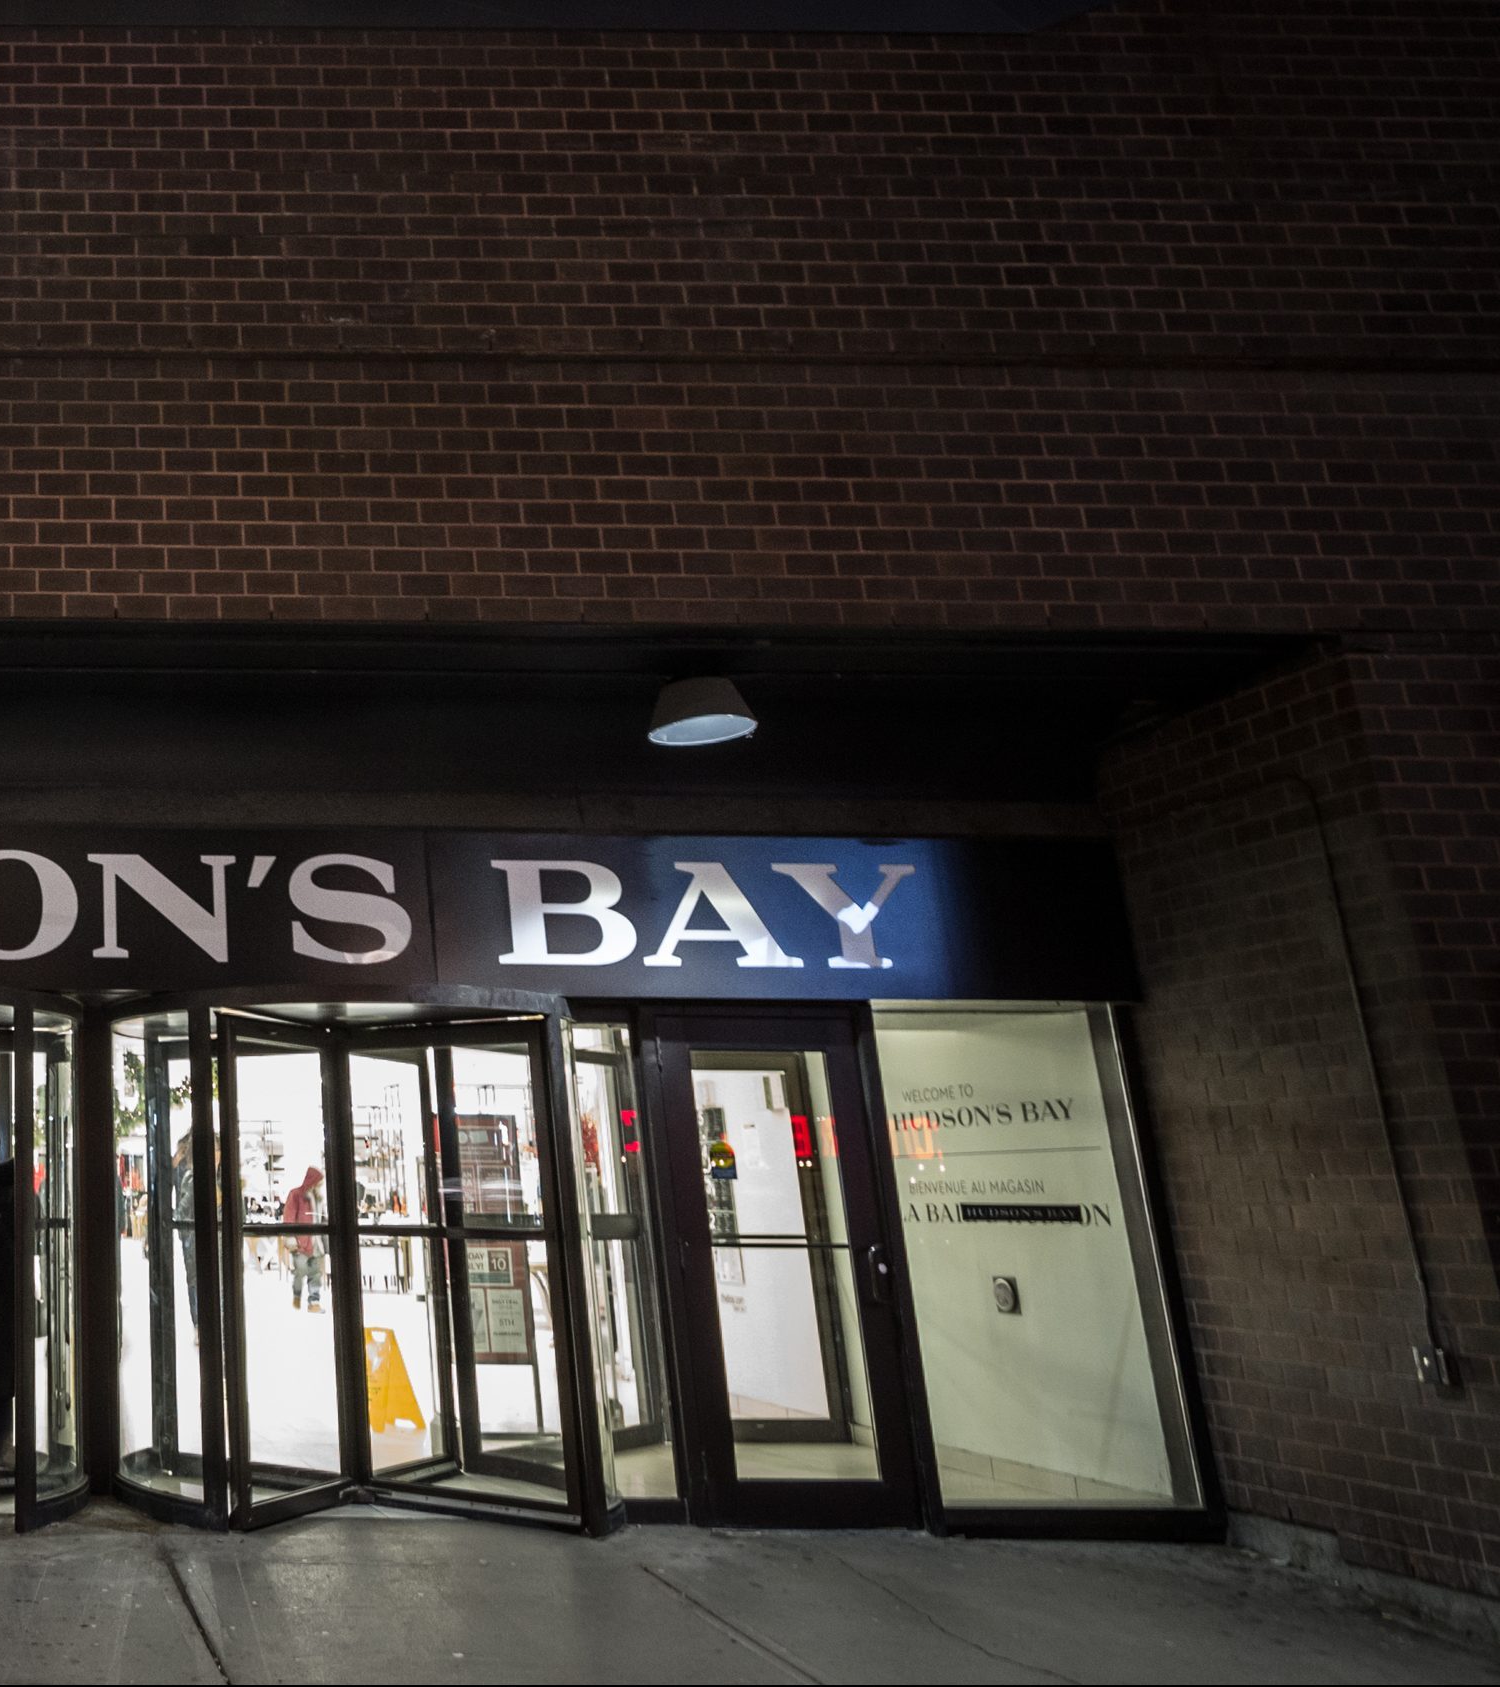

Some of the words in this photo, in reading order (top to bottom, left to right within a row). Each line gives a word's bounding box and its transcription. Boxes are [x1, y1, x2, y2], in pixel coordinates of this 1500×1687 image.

[490, 859, 916, 969] BAY
[902, 1085, 955, 1103] WELCOME
[958, 1083, 974, 1099] TO
[891, 1102, 1013, 1131] HUDSON'S
[1020, 1097, 1073, 1123] BAY
[909, 1178, 967, 1195] BIENVENUE
[970, 1180, 987, 1195] AU
[988, 1179, 1046, 1195] MAGASIN
[904, 1203, 921, 1222] A
[966, 1206, 1045, 1218] HUDSON'S
[1048, 1207, 1077, 1218] BAY
[491, 1258, 507, 1271] 10
